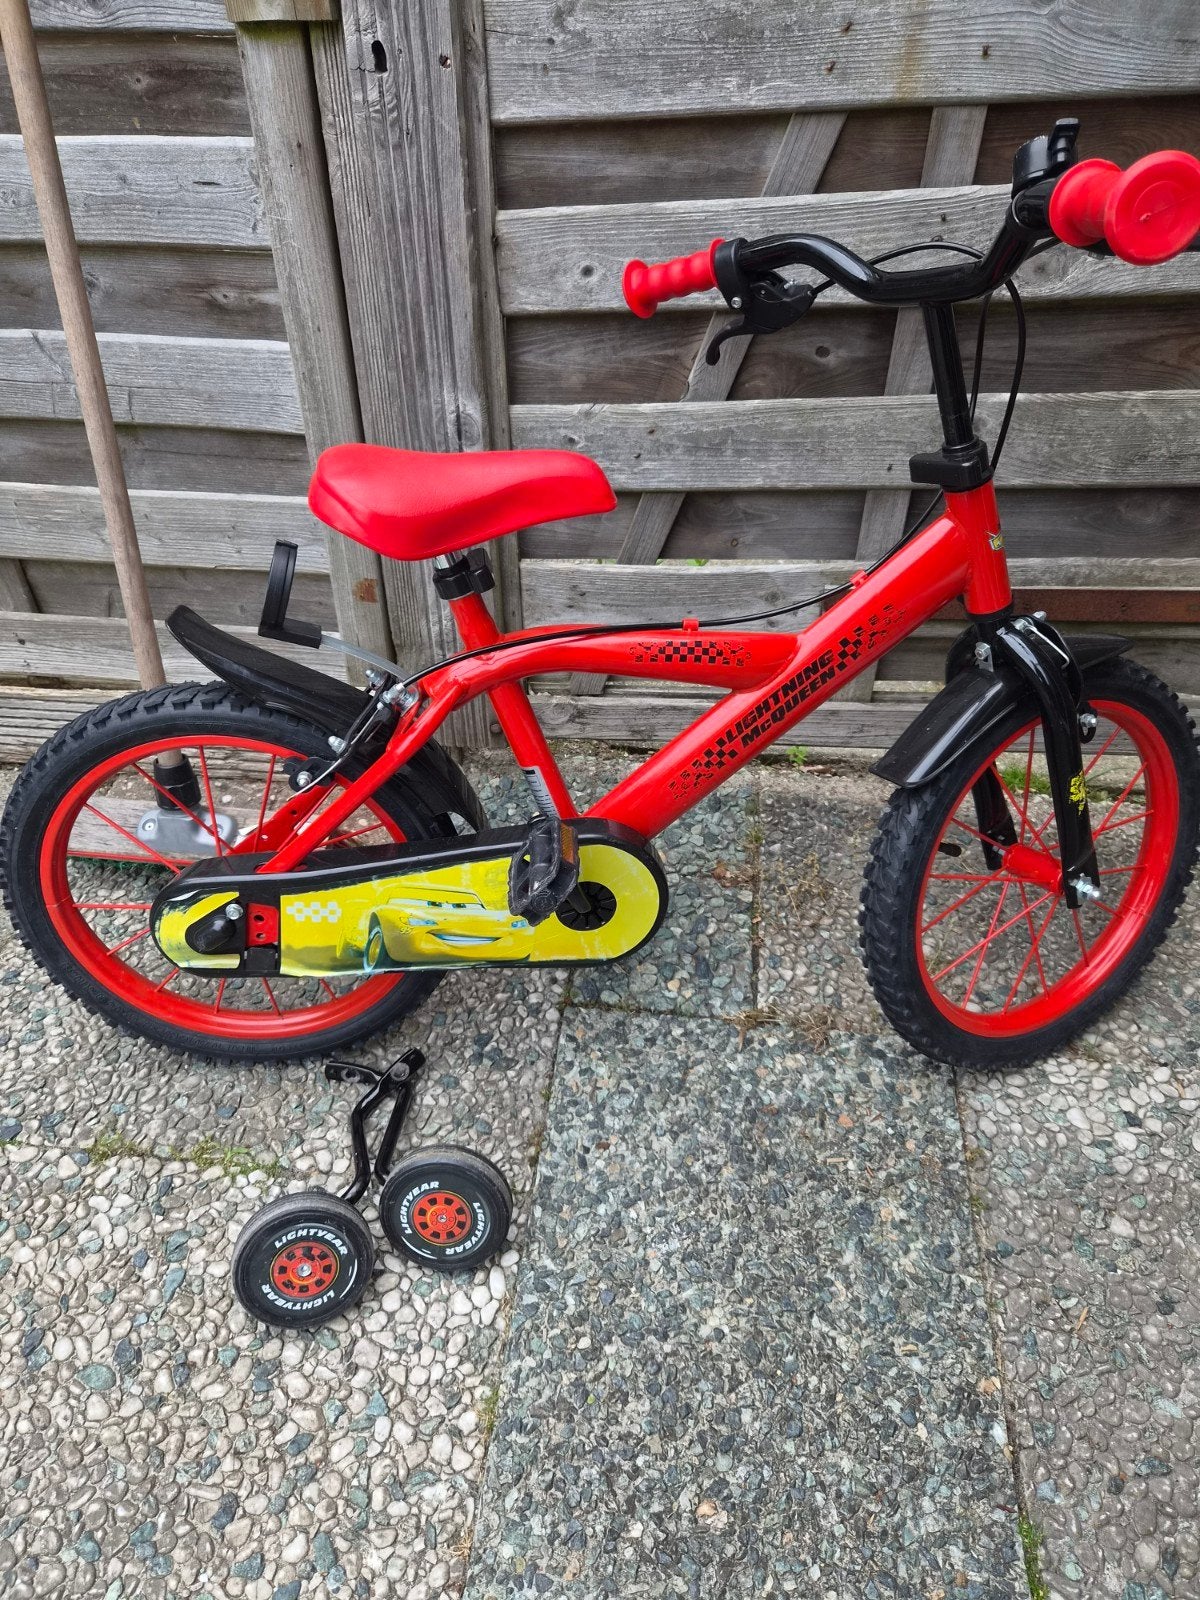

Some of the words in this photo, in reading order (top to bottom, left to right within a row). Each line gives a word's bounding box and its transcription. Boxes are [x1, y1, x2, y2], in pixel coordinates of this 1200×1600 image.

[725, 649, 834, 744] LIGHTNING
[741, 668, 835, 748] McQUEEN
[401, 1181, 440, 1235] LIGHTYEAR
[445, 1202, 491, 1256] LIGHTYEAR
[274, 1227, 348, 1256] LIGHTYEAR
[261, 1283, 335, 1312] LIGHTYEAR
